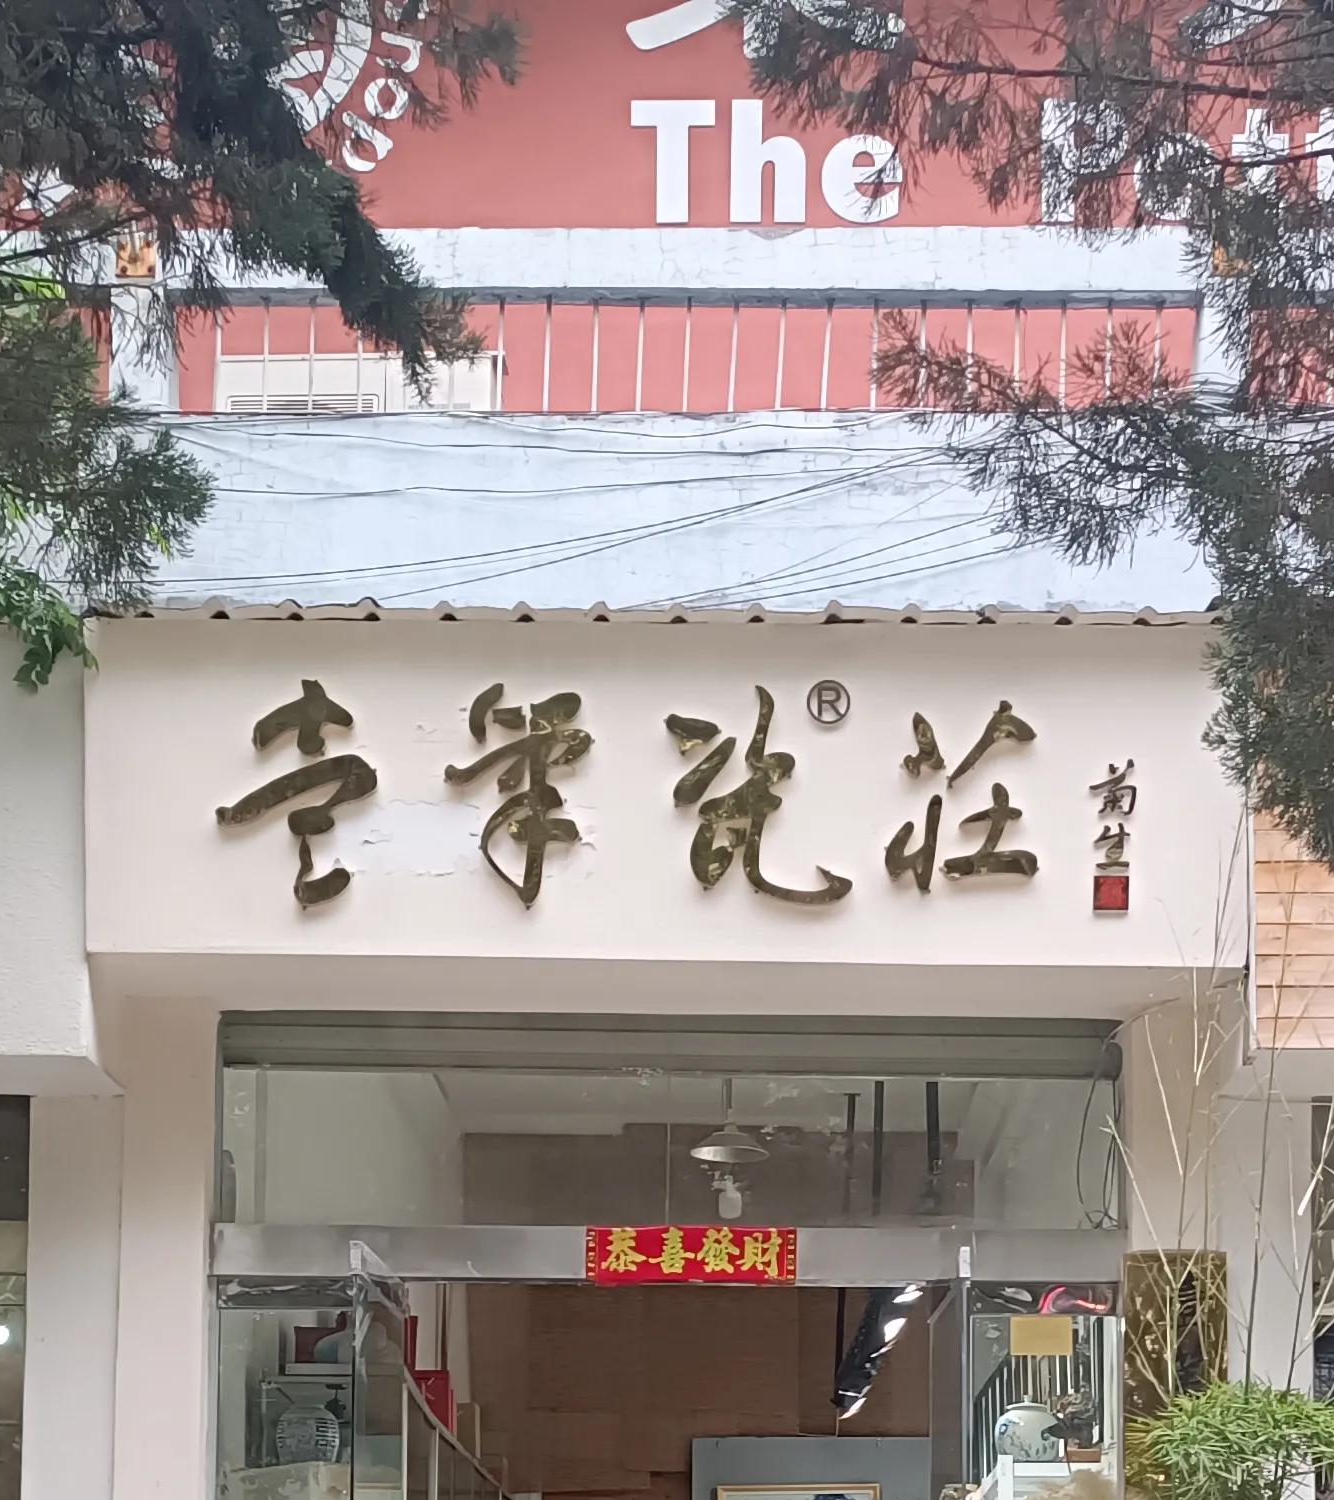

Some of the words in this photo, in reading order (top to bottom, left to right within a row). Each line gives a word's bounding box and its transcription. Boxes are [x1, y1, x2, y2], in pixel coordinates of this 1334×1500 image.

[629, 98, 903, 226] The
[600, 1226, 783, 1278] 恭喜發財
